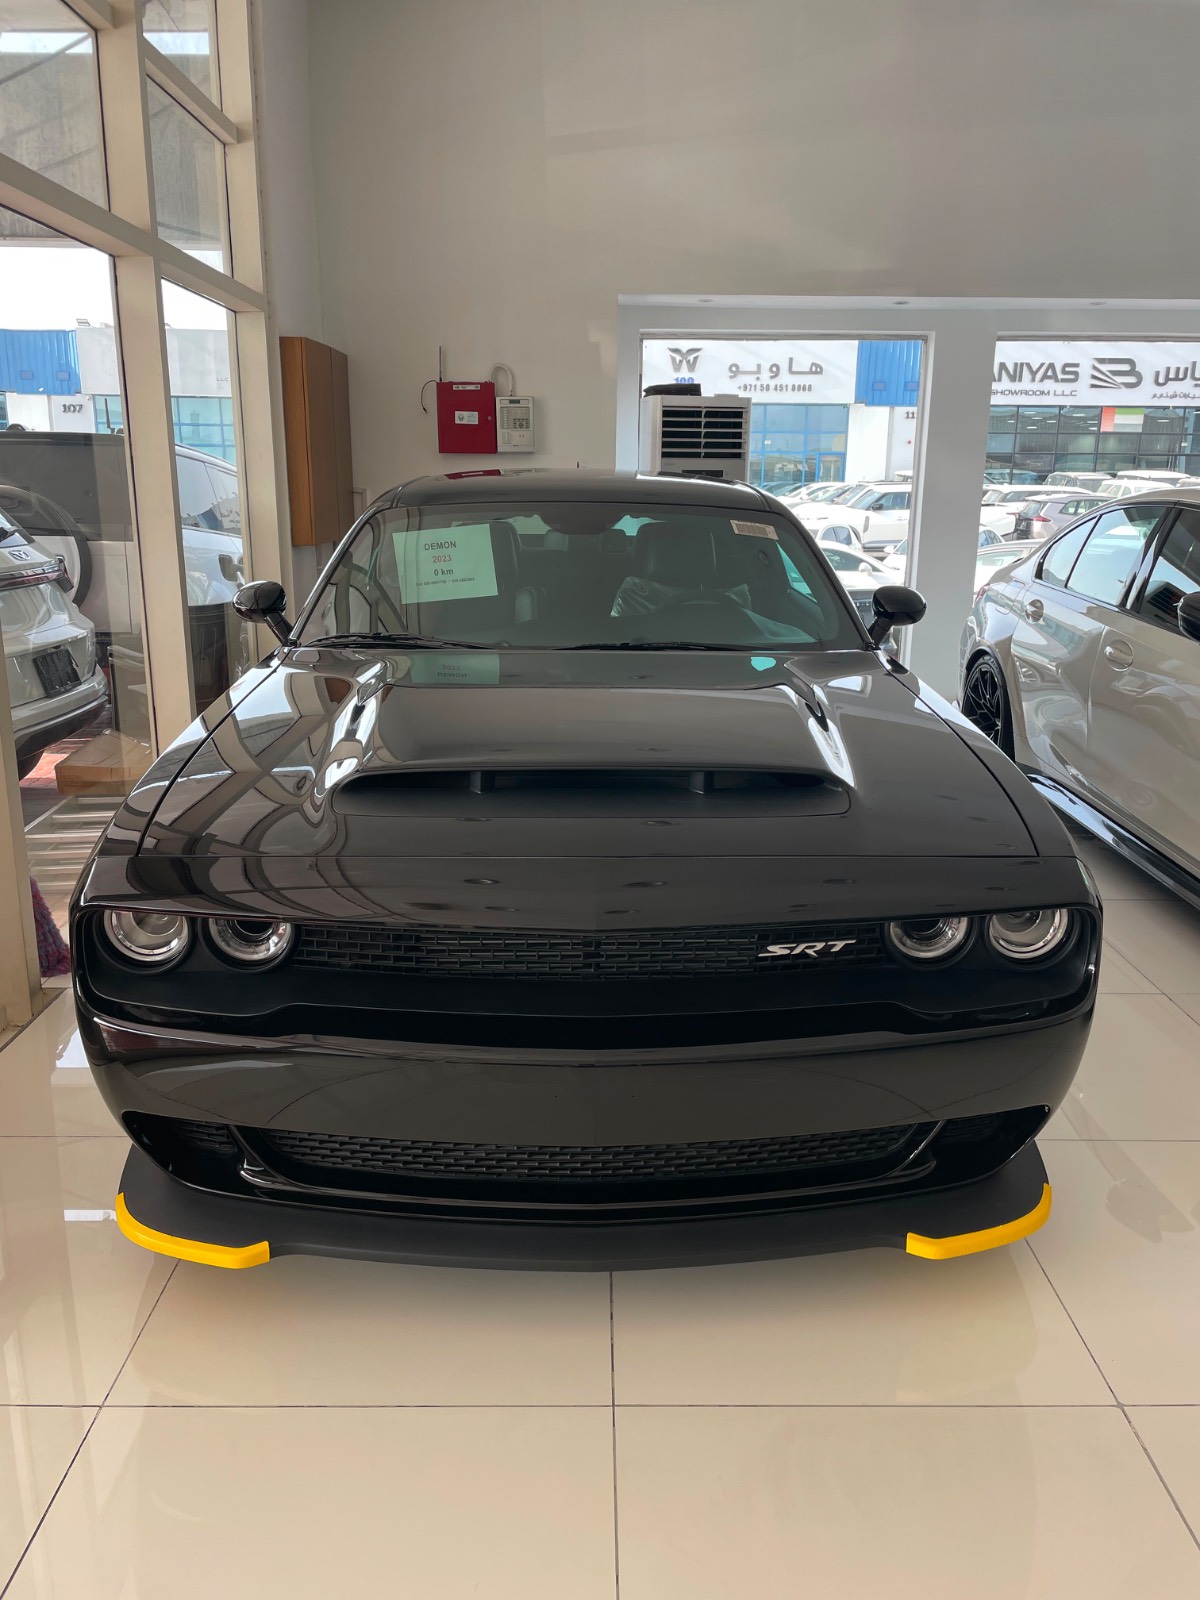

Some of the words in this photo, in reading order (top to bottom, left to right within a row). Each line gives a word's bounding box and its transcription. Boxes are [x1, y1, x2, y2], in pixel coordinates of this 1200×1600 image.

[737, 383, 757, 392] +971
[760, 383, 770, 392] 50
[1053, 389, 1078, 397] LLC
[62, 403, 83, 413] 107
[424, 540, 457, 551] DEMON
[432, 554, 452, 563] 2023
[433, 568, 439, 577] 0
[441, 568, 454, 576] km
[758, 939, 857, 957] SRT
